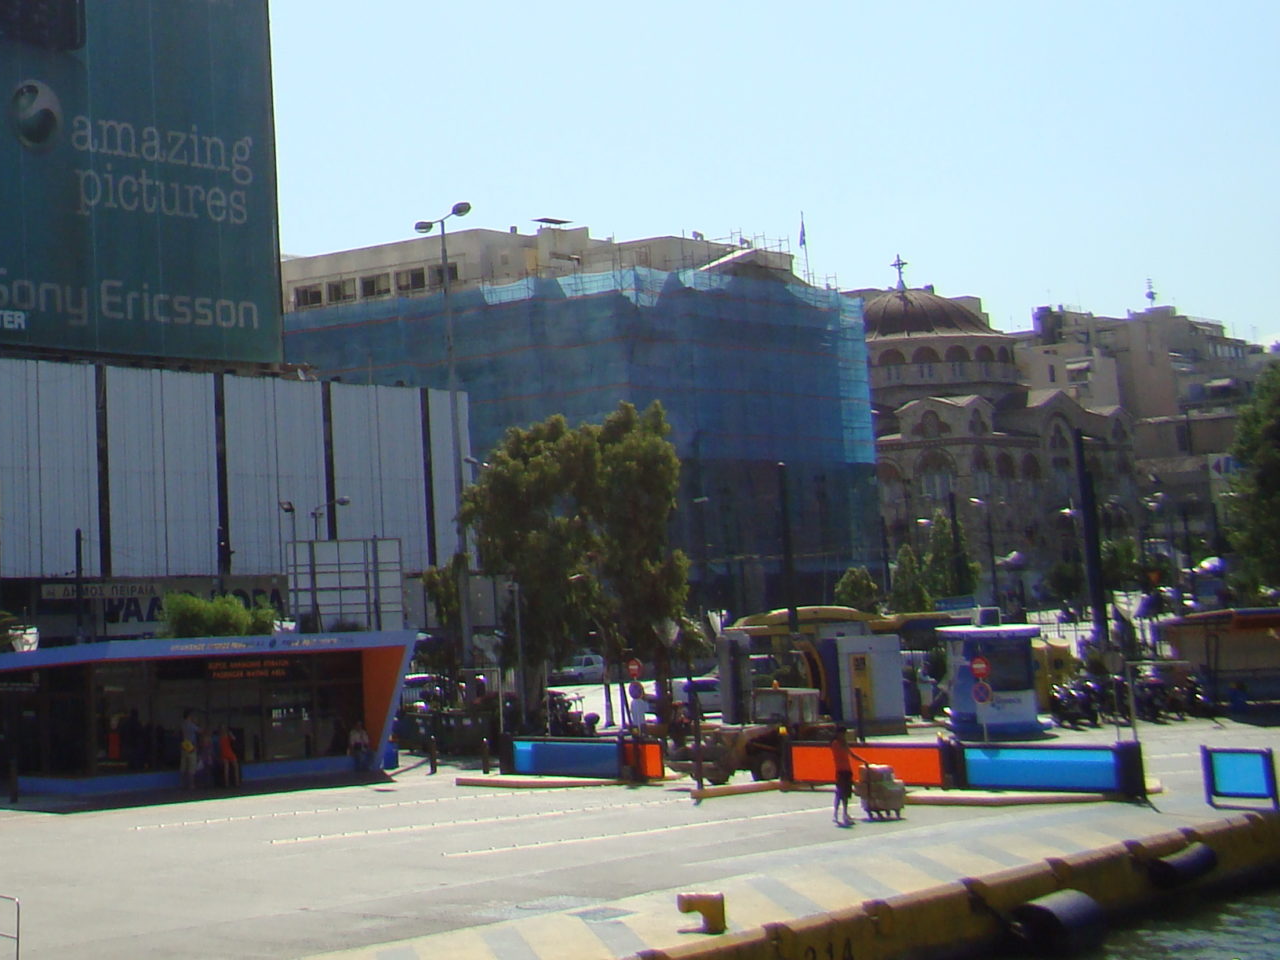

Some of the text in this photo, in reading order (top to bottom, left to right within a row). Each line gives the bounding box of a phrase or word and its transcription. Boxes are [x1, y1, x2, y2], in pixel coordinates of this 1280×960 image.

[71, 114, 253, 185] amazing
[75, 163, 248, 225] pictures
[100, 279, 259, 330] Ericsson
[110, 585, 157, 597] ΠΕΙΡΑΙΑ
